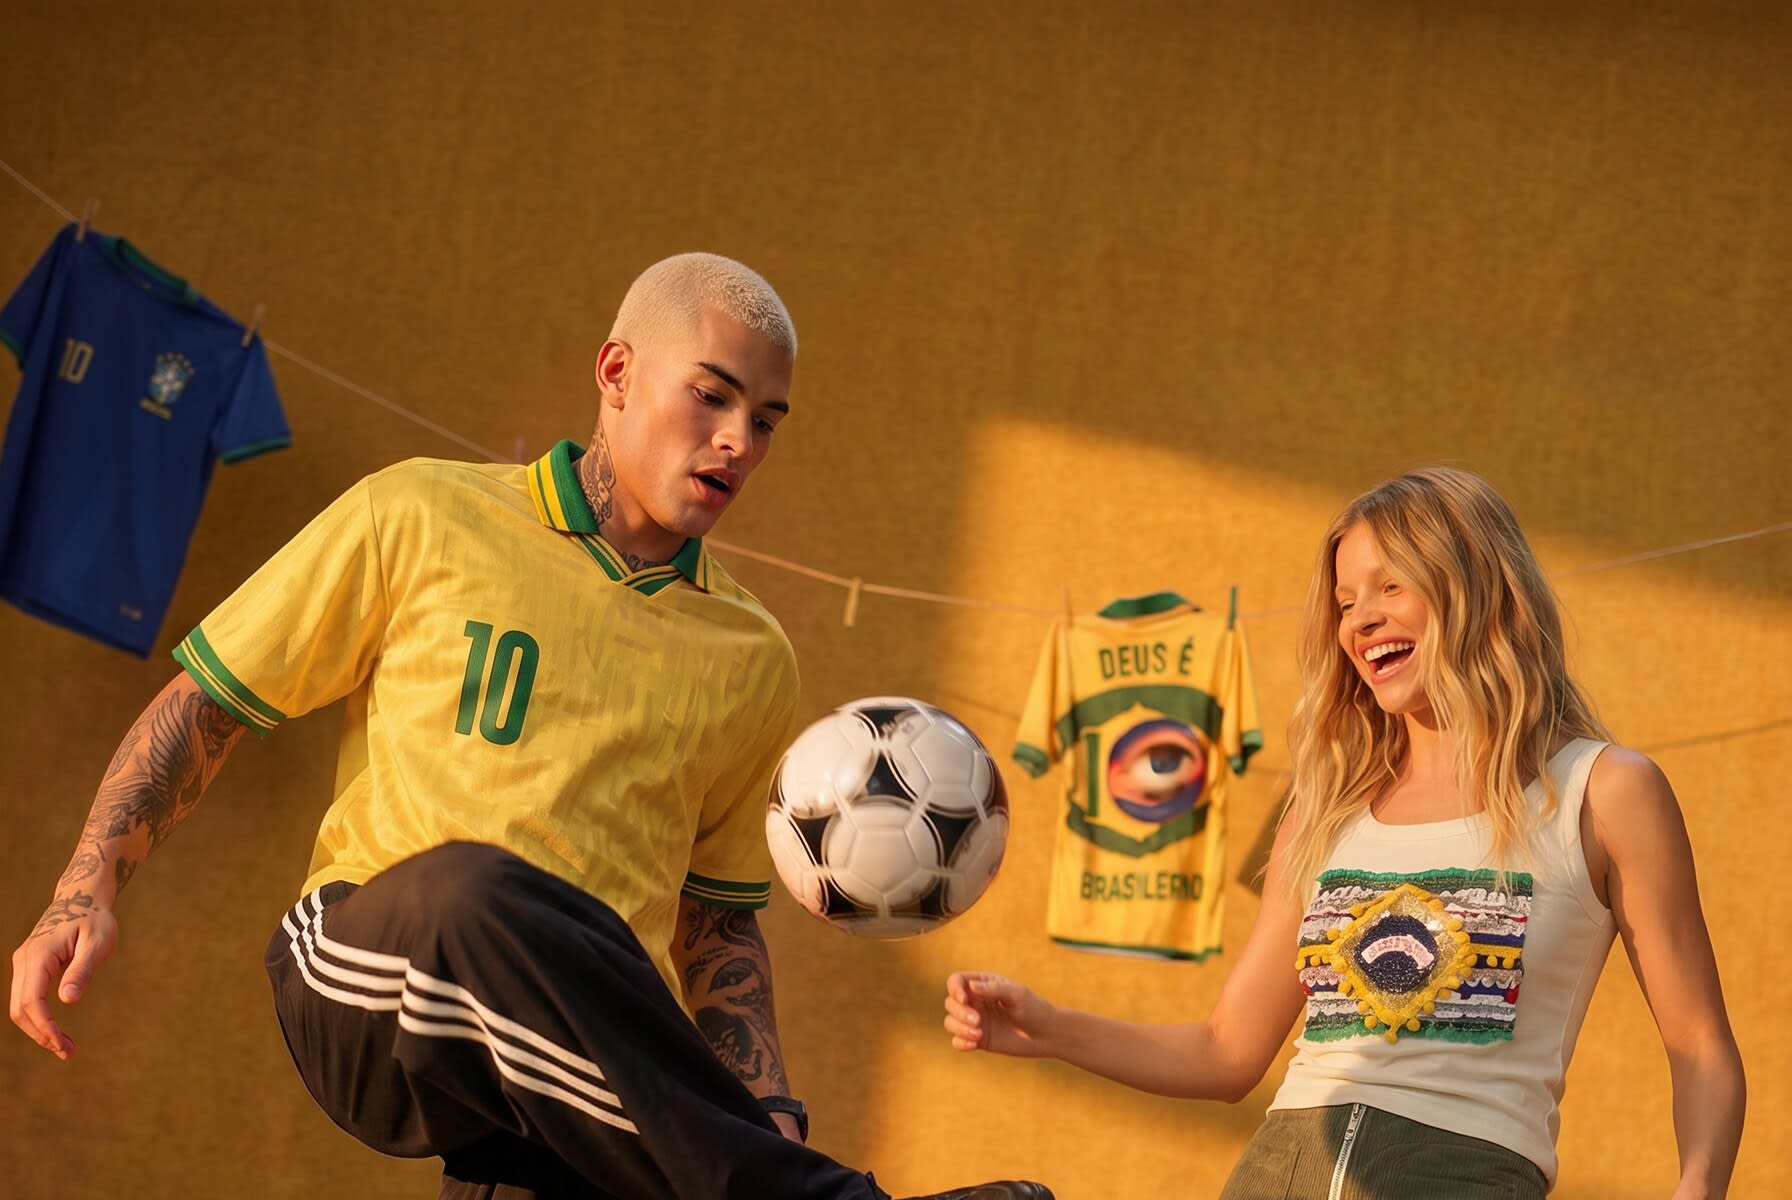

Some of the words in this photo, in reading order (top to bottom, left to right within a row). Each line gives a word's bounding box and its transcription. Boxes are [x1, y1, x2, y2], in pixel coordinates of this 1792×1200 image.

[60, 338, 94, 384] 10
[1099, 641, 1167, 679] DEUS
[1179, 635, 1194, 675] É
[455, 619, 540, 746] 10
